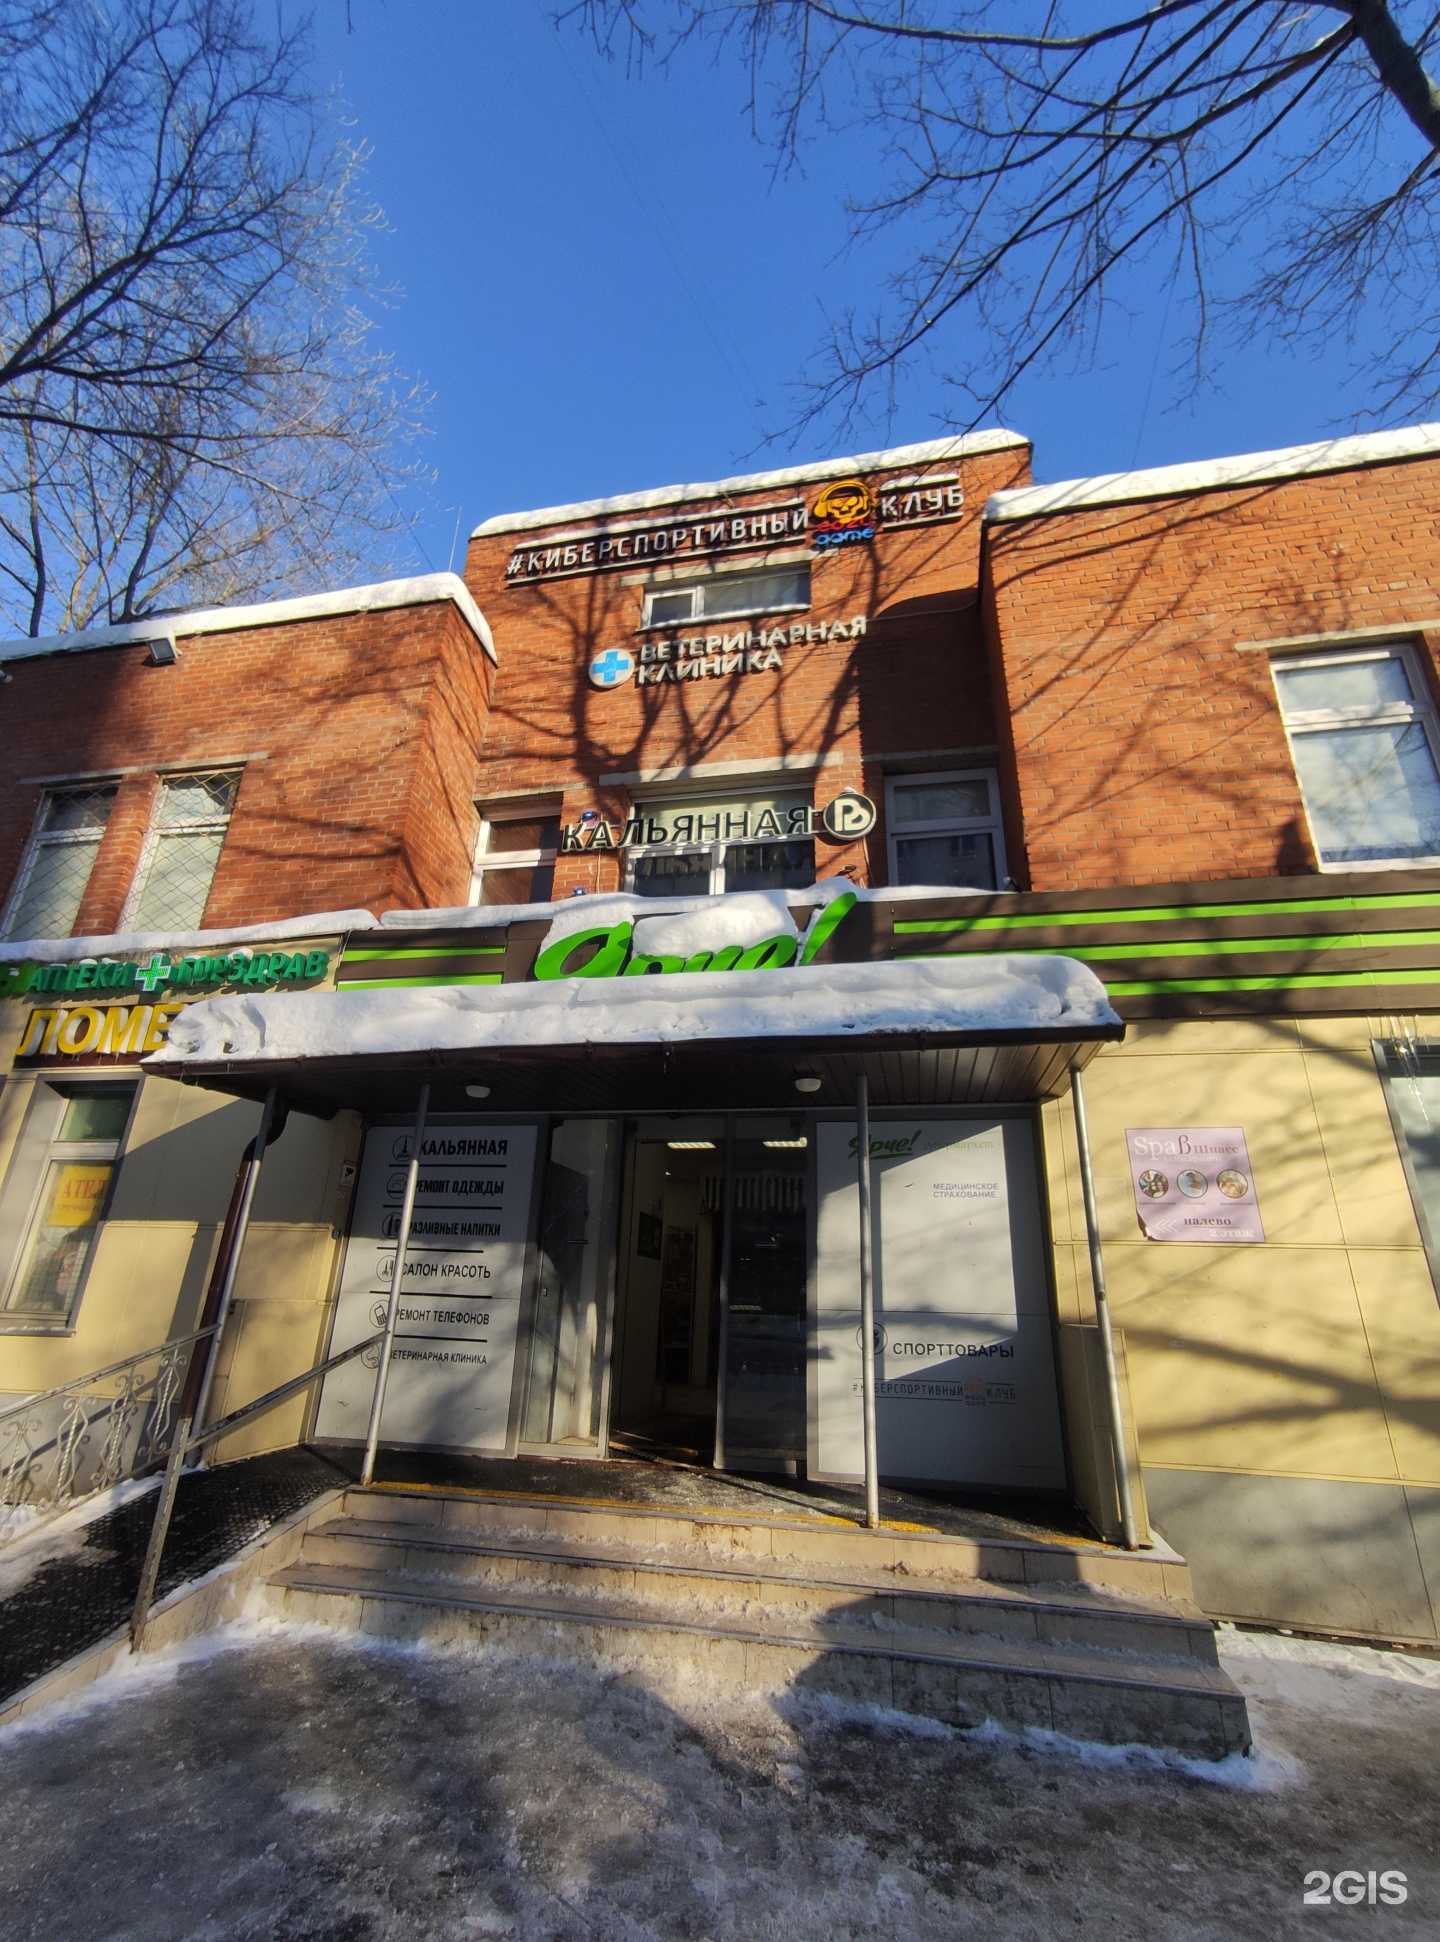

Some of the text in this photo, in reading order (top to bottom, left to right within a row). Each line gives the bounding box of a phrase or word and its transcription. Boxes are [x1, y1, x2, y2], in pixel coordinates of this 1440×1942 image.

[507, 485, 965, 575] #КИБЕРСПОРТИВНЫЙ КЛУБ
[640, 615, 868, 665] ВЕТЕРИНАРНАЯ
[637, 645, 784, 686] КЛИНИКА
[562, 805, 813, 852] КАЛЬЯННАЯ
[451, 1180, 505, 1197] ОДЕЖДЫ
[933, 1183, 1000, 1191] МЕДИЦИНСКОЕ
[933, 1191, 997, 1199] СТРАХОВАНИЕ
[460, 1222, 501, 1237] НАПИТКИ
[402, 1263, 438, 1277] САЛОН
[433, 1310, 490, 1325] ТЕЛЕФОНОВ
[392, 1350, 487, 1365] ЕТЕРИНАРНАЯ КЛИНИКА
[893, 1343, 1015, 1358] СПОРТТОВАРЫ
